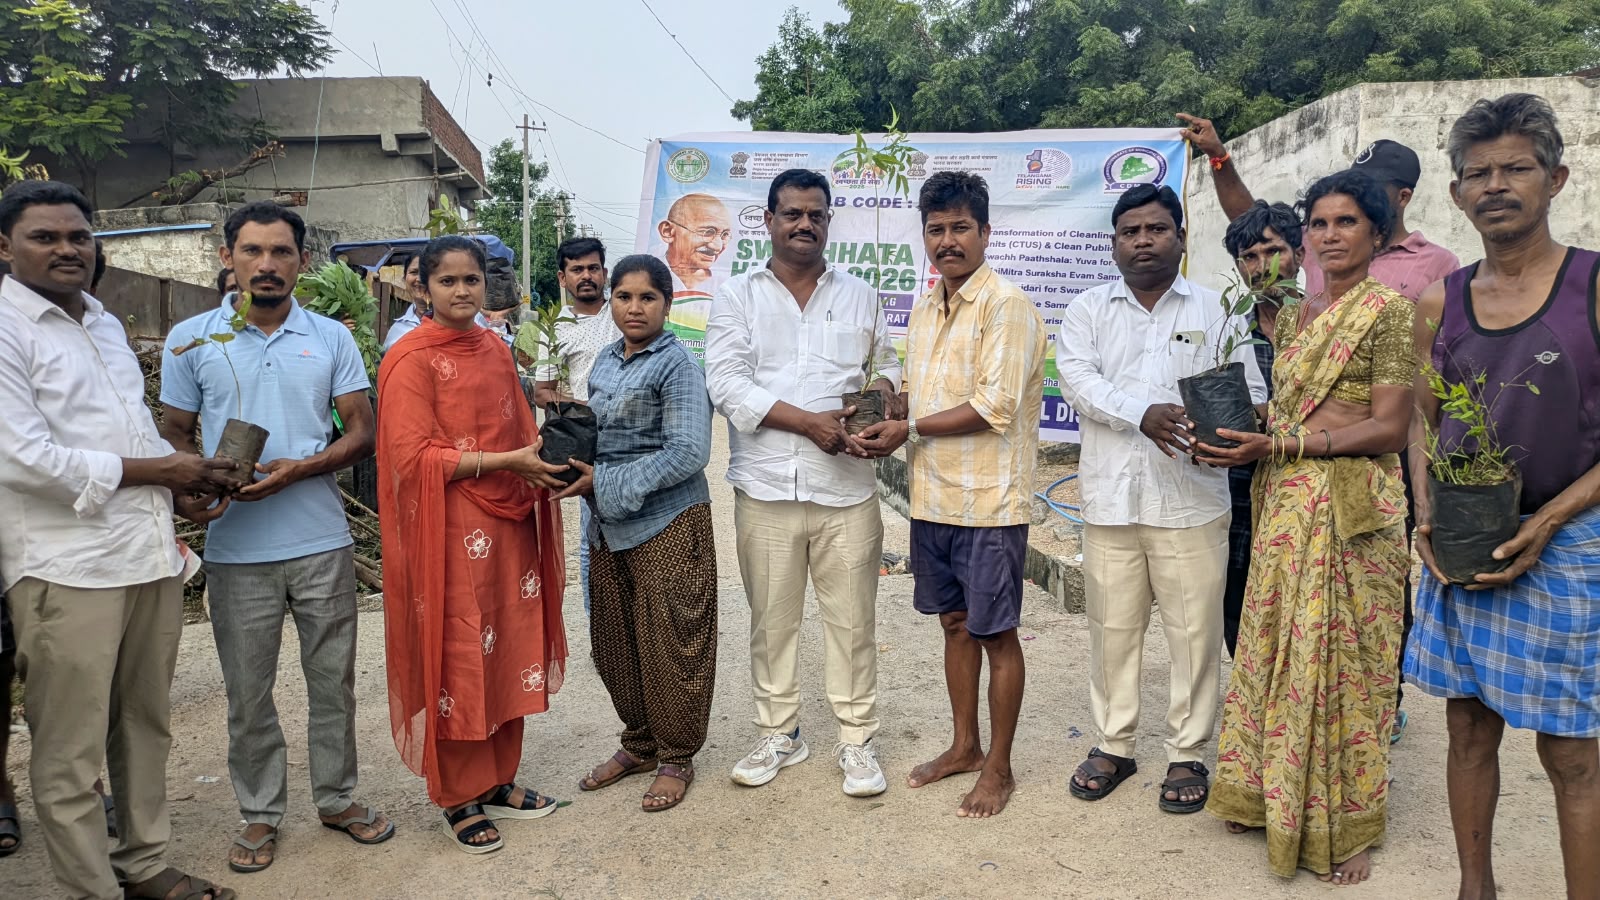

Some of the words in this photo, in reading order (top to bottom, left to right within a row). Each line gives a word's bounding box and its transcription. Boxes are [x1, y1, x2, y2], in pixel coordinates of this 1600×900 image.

[852, 196, 903, 208] CODE
[1009, 240, 1042, 250] (CTUS)
[1054, 242, 1082, 251] Clean
[1019, 254, 1072, 264] Paathshala:
[1075, 256, 1097, 265] Yuva
[1100, 258, 1112, 266] for
[1025, 268, 1067, 278] Suraksha
[1069, 271, 1095, 279] Evam
[1044, 285, 1058, 293] for
